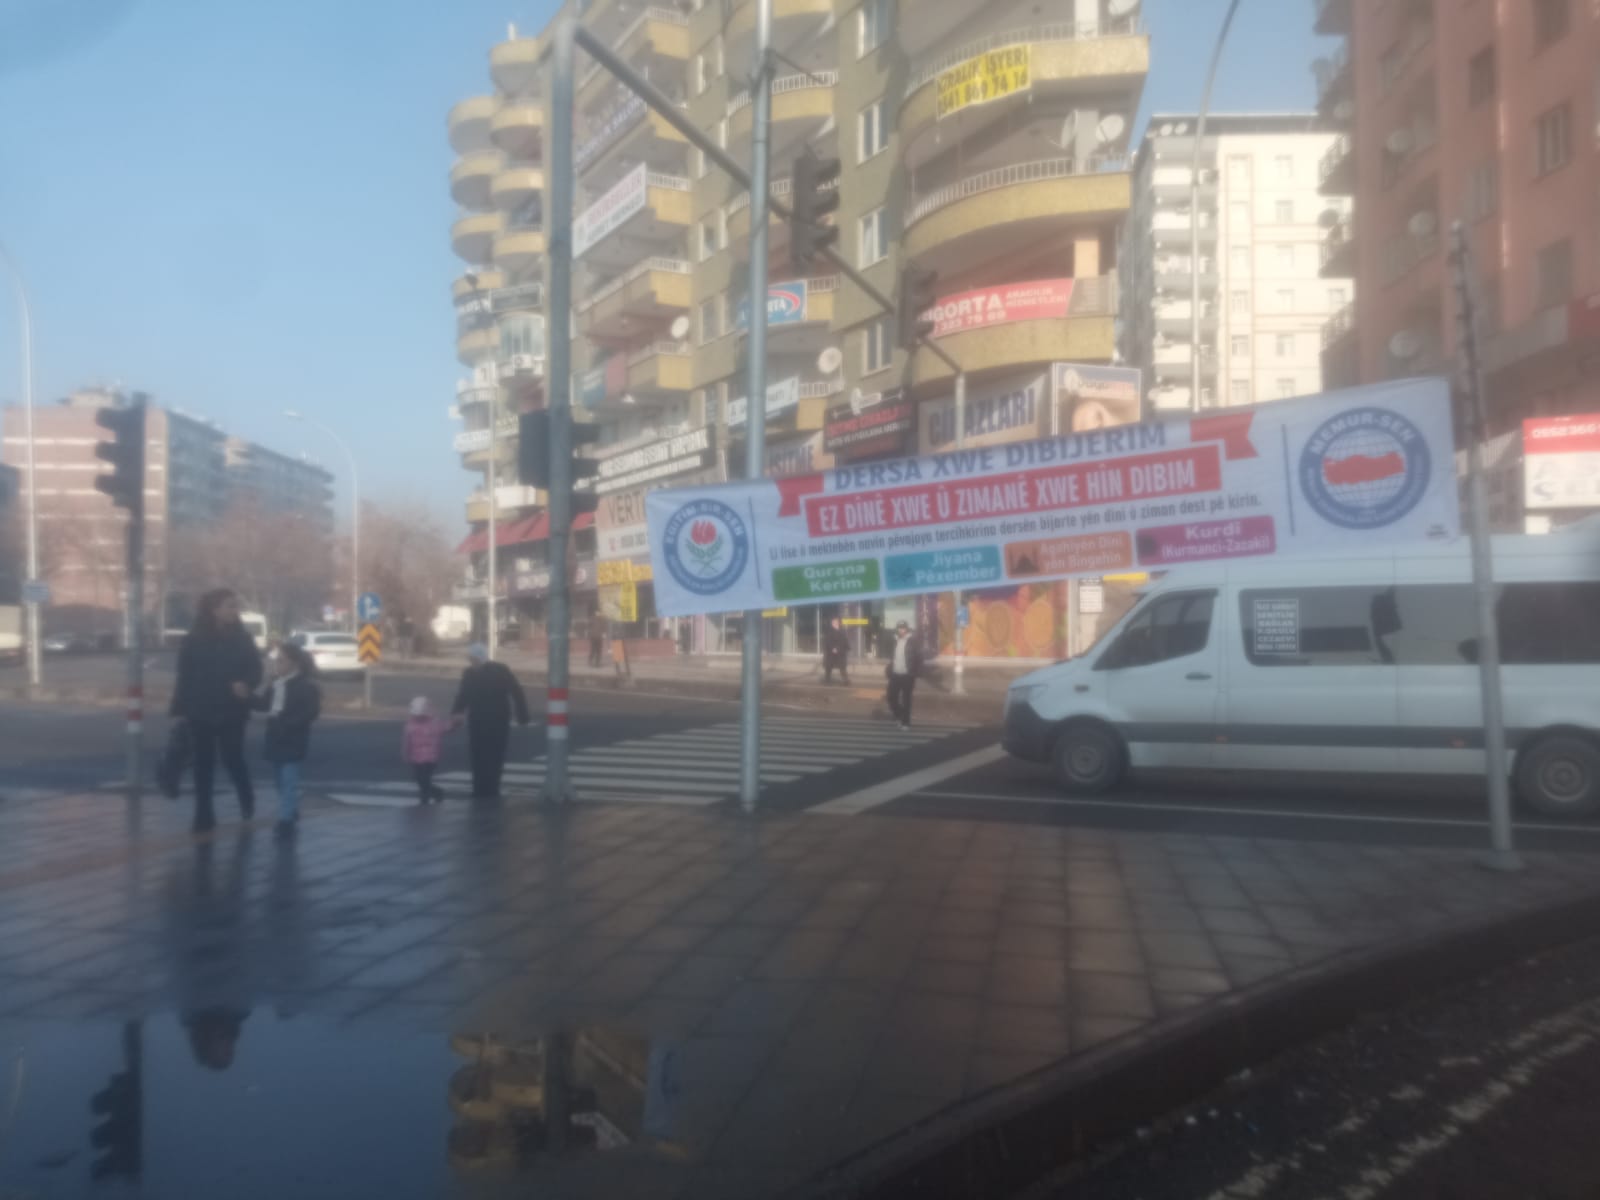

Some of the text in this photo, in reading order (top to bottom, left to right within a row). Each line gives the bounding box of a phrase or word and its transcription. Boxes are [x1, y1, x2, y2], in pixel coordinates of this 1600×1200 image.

[1310, 411, 1416, 455] MEMUR-SEN
[835, 458, 922, 490] DERSA
[932, 450, 993, 479] XWE
[819, 505, 841, 533] EZ
[891, 493, 931, 524] XWE
[936, 485, 950, 519] Û
[956, 473, 1030, 516] ZIMANÊ
[1036, 474, 1080, 506] XWE
[1131, 459, 1196, 495] DIBIM
[1141, 504, 1176, 519] ziman
[1180, 499, 1206, 514] dest
[804, 564, 866, 579] Qurana
[931, 551, 982, 568] Jiyana
